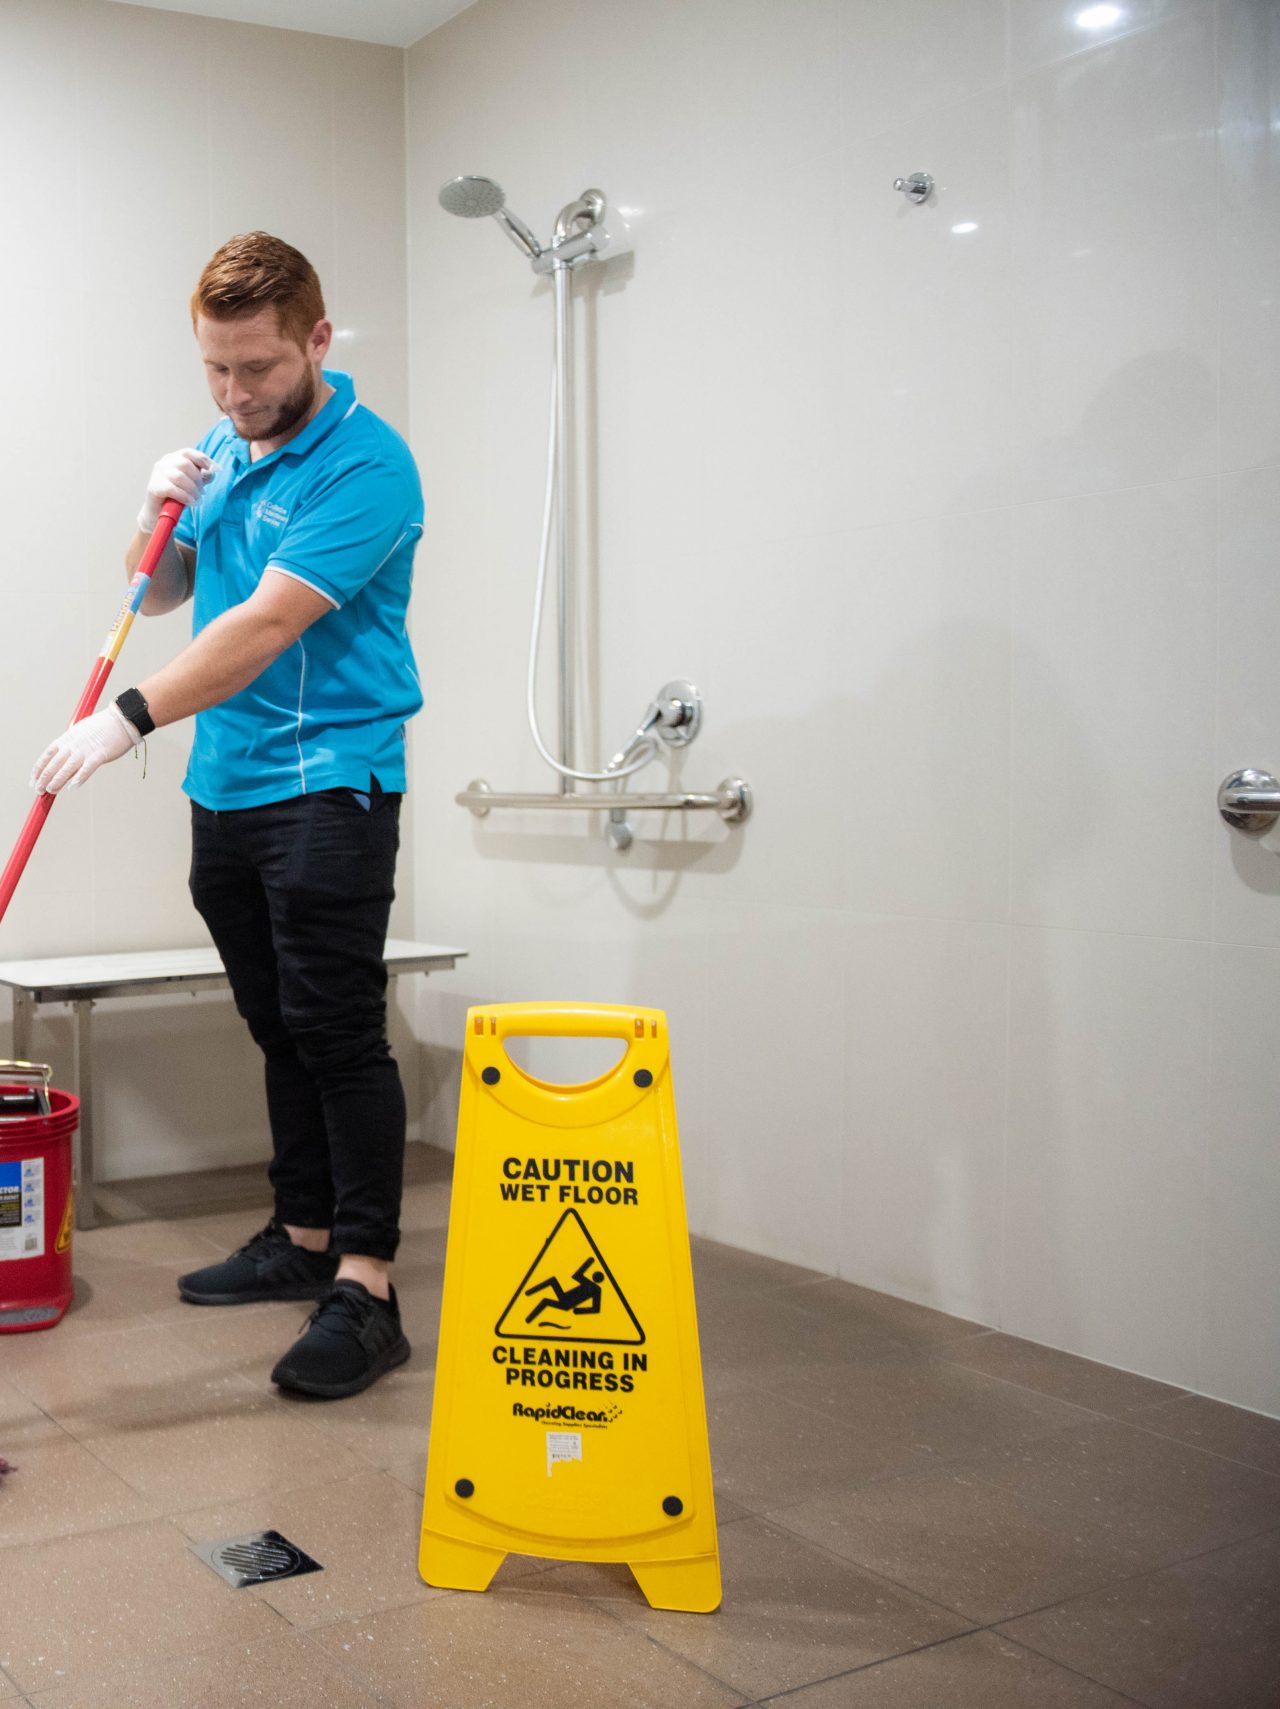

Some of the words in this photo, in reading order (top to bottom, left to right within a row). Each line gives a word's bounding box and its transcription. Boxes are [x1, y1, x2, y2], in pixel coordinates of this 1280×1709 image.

[502, 1157, 634, 1183] CAUTION
[500, 1184, 550, 1202] WET
[559, 1185, 638, 1206] FLOOR
[492, 1346, 614, 1370] CLEANING
[623, 1353, 648, 1372] IN
[506, 1368, 635, 1393] PROGRESS
[512, 1402, 608, 1422] RapidClean
